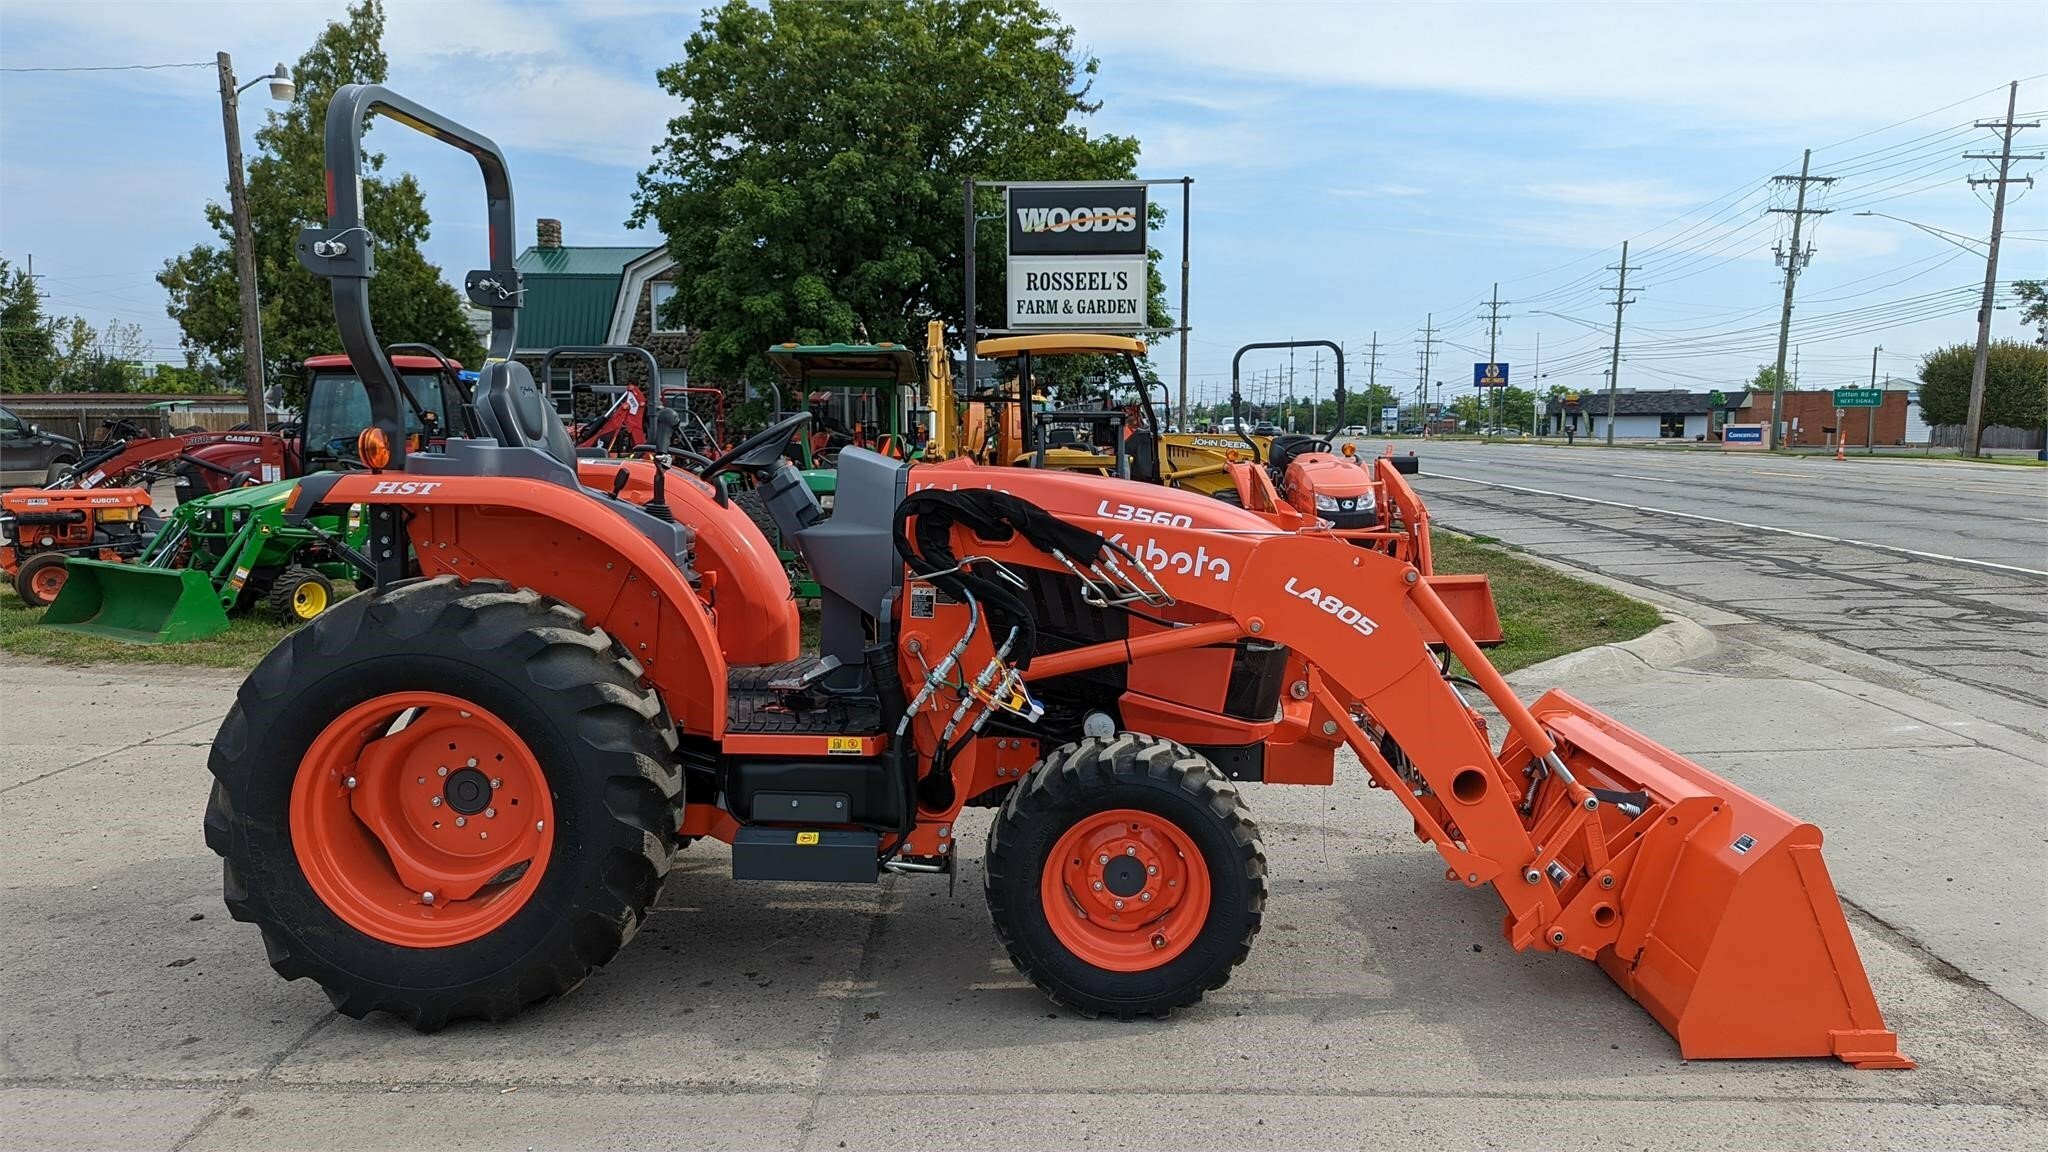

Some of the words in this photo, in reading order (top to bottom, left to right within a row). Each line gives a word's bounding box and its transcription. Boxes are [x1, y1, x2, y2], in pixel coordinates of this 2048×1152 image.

[1016, 206, 1137, 233] WOODS
[1026, 271, 1128, 292] ROSSEEL'S
[1016, 299, 1059, 314] FARM
[1062, 299, 1074, 315] &
[1077, 299, 1137, 314] GARDEN
[1192, 438, 1217, 447] JOHN
[370, 481, 442, 495] HST
[1097, 500, 1193, 528] L3560
[1096, 530, 1231, 582] Kubota
[1284, 576, 1379, 636] LA805
